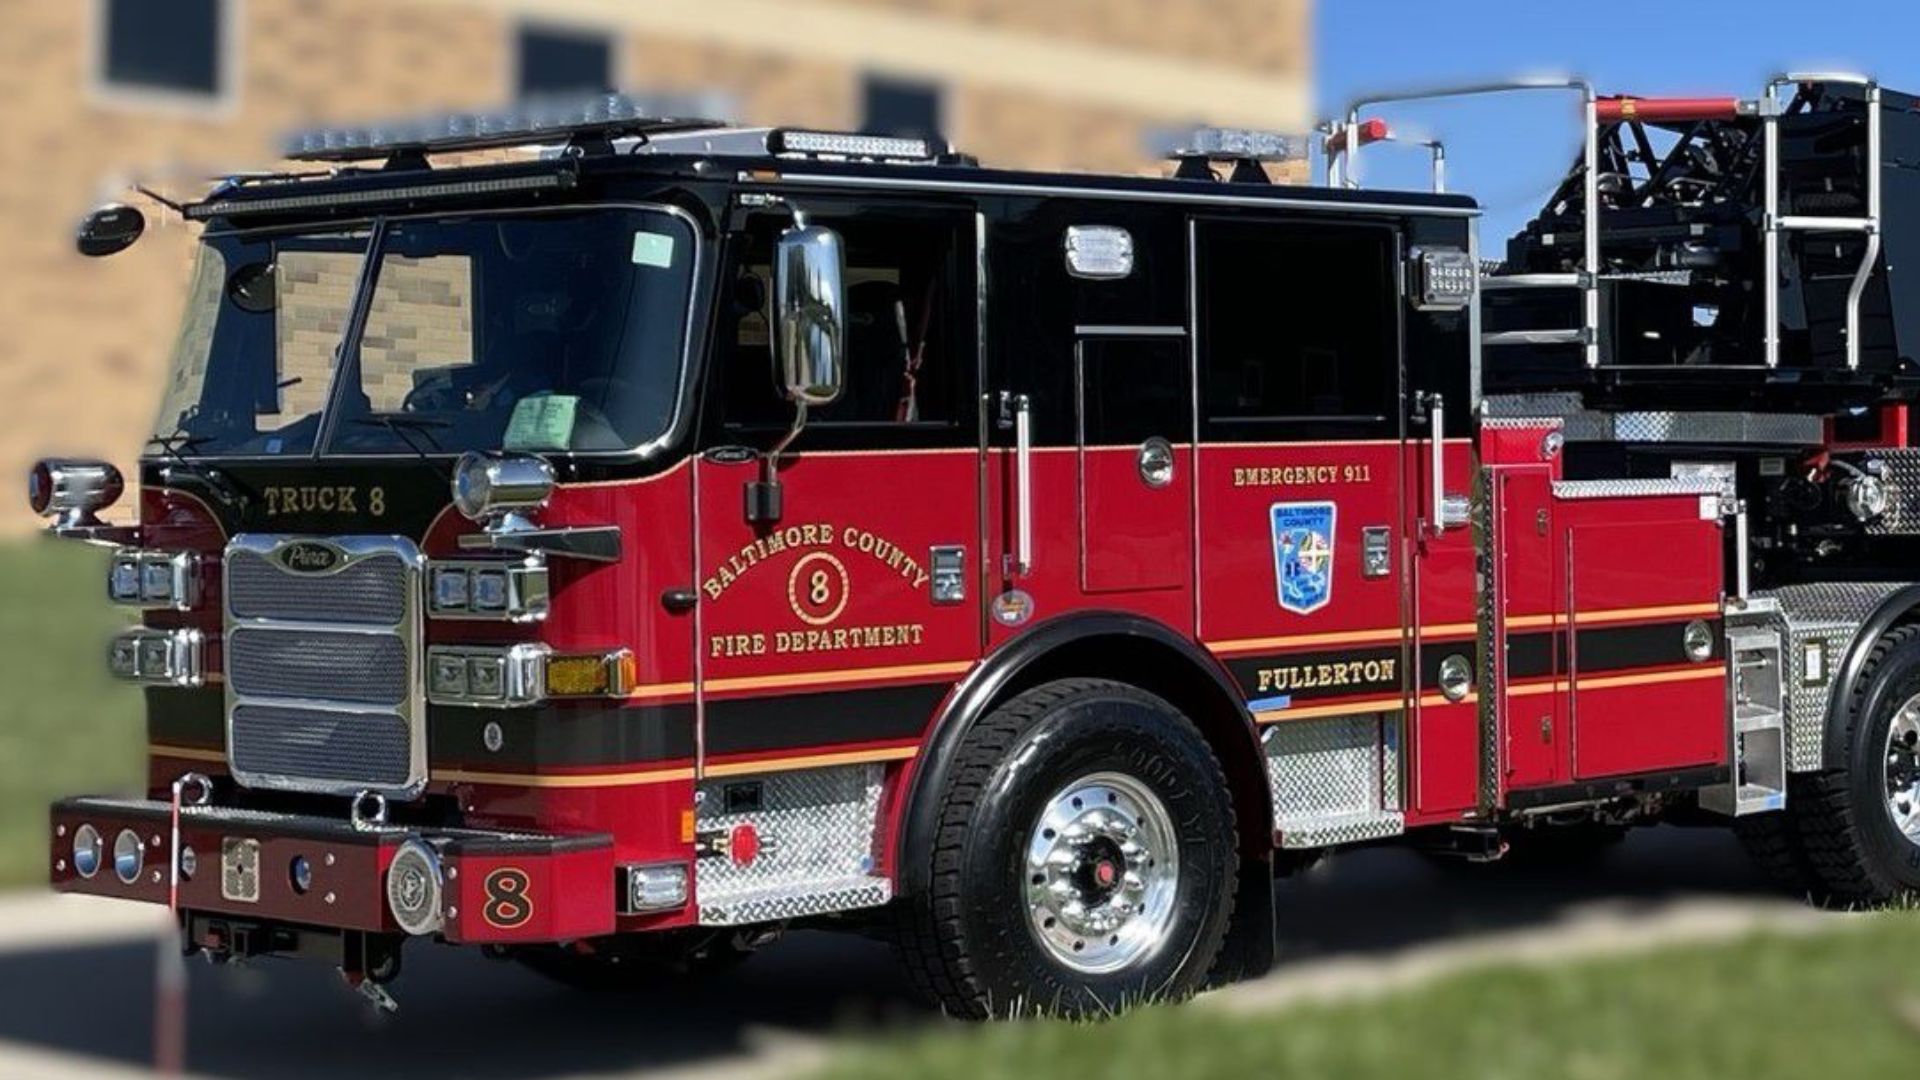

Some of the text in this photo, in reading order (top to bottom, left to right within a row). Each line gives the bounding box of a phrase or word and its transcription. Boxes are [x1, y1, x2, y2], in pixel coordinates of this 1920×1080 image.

[1234, 464, 1371, 486] EMERGENCY 911
[264, 486, 385, 516] TRUCK 8
[1276, 506, 1332, 518] BALTIMORE
[1283, 517, 1325, 527] COUNTY
[703, 523, 930, 600] BALTIMORE COUNTY
[811, 569, 830, 604] 8
[711, 623, 924, 657] FIRE DEPARTMENT
[1257, 658, 1396, 691] FULLERTON
[482, 866, 534, 928] 8
